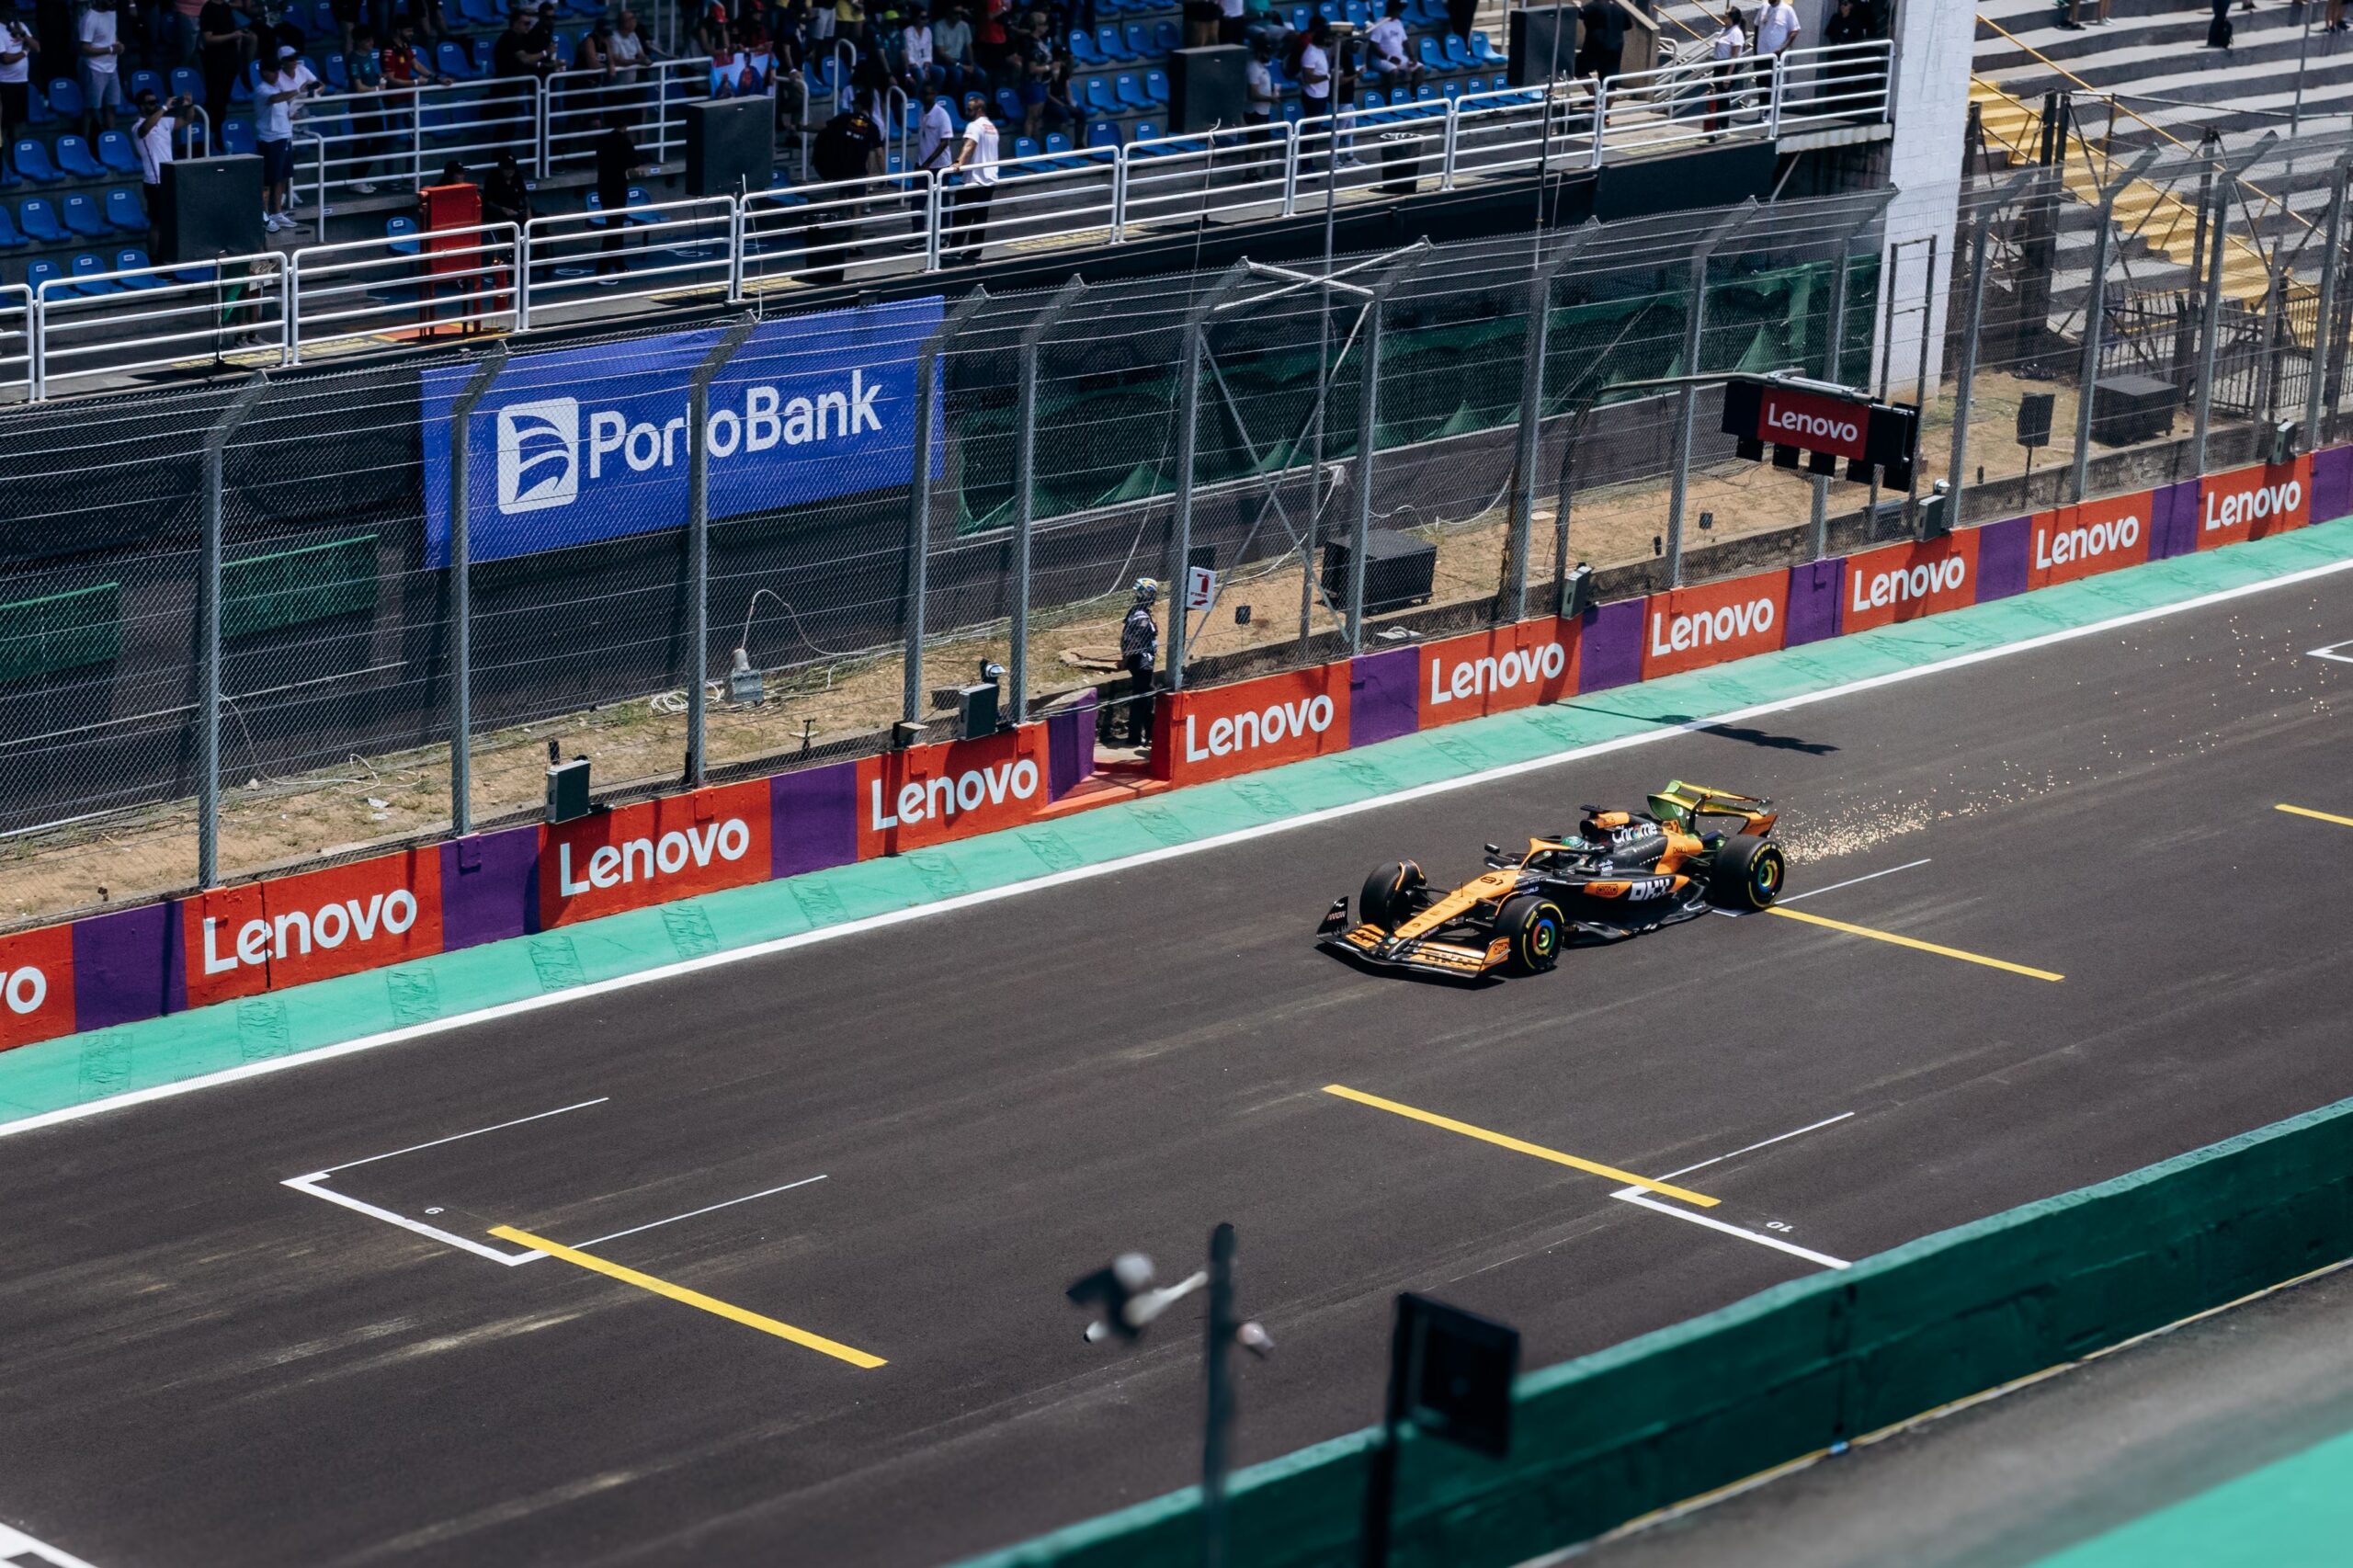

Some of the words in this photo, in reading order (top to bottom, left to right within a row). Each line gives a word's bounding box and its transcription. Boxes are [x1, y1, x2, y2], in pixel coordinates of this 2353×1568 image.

[588, 369, 883, 480] PoroBank
[1768, 403, 1858, 443] Lenovo
[2205, 480, 2302, 531] Lenovo
[2036, 515, 2140, 570] Lenovo
[1852, 555, 1966, 612] Lenovo
[1651, 597, 1775, 657] Lenovo
[1430, 642, 1564, 705] Lenovo
[1186, 694, 1334, 763] Lenovo
[871, 759, 1039, 832] Lenovo
[560, 818, 750, 898] Lenovo
[1611, 822, 1658, 844] Chrome
[1480, 876, 1504, 886] 81
[203, 889, 418, 975] Lenovo
